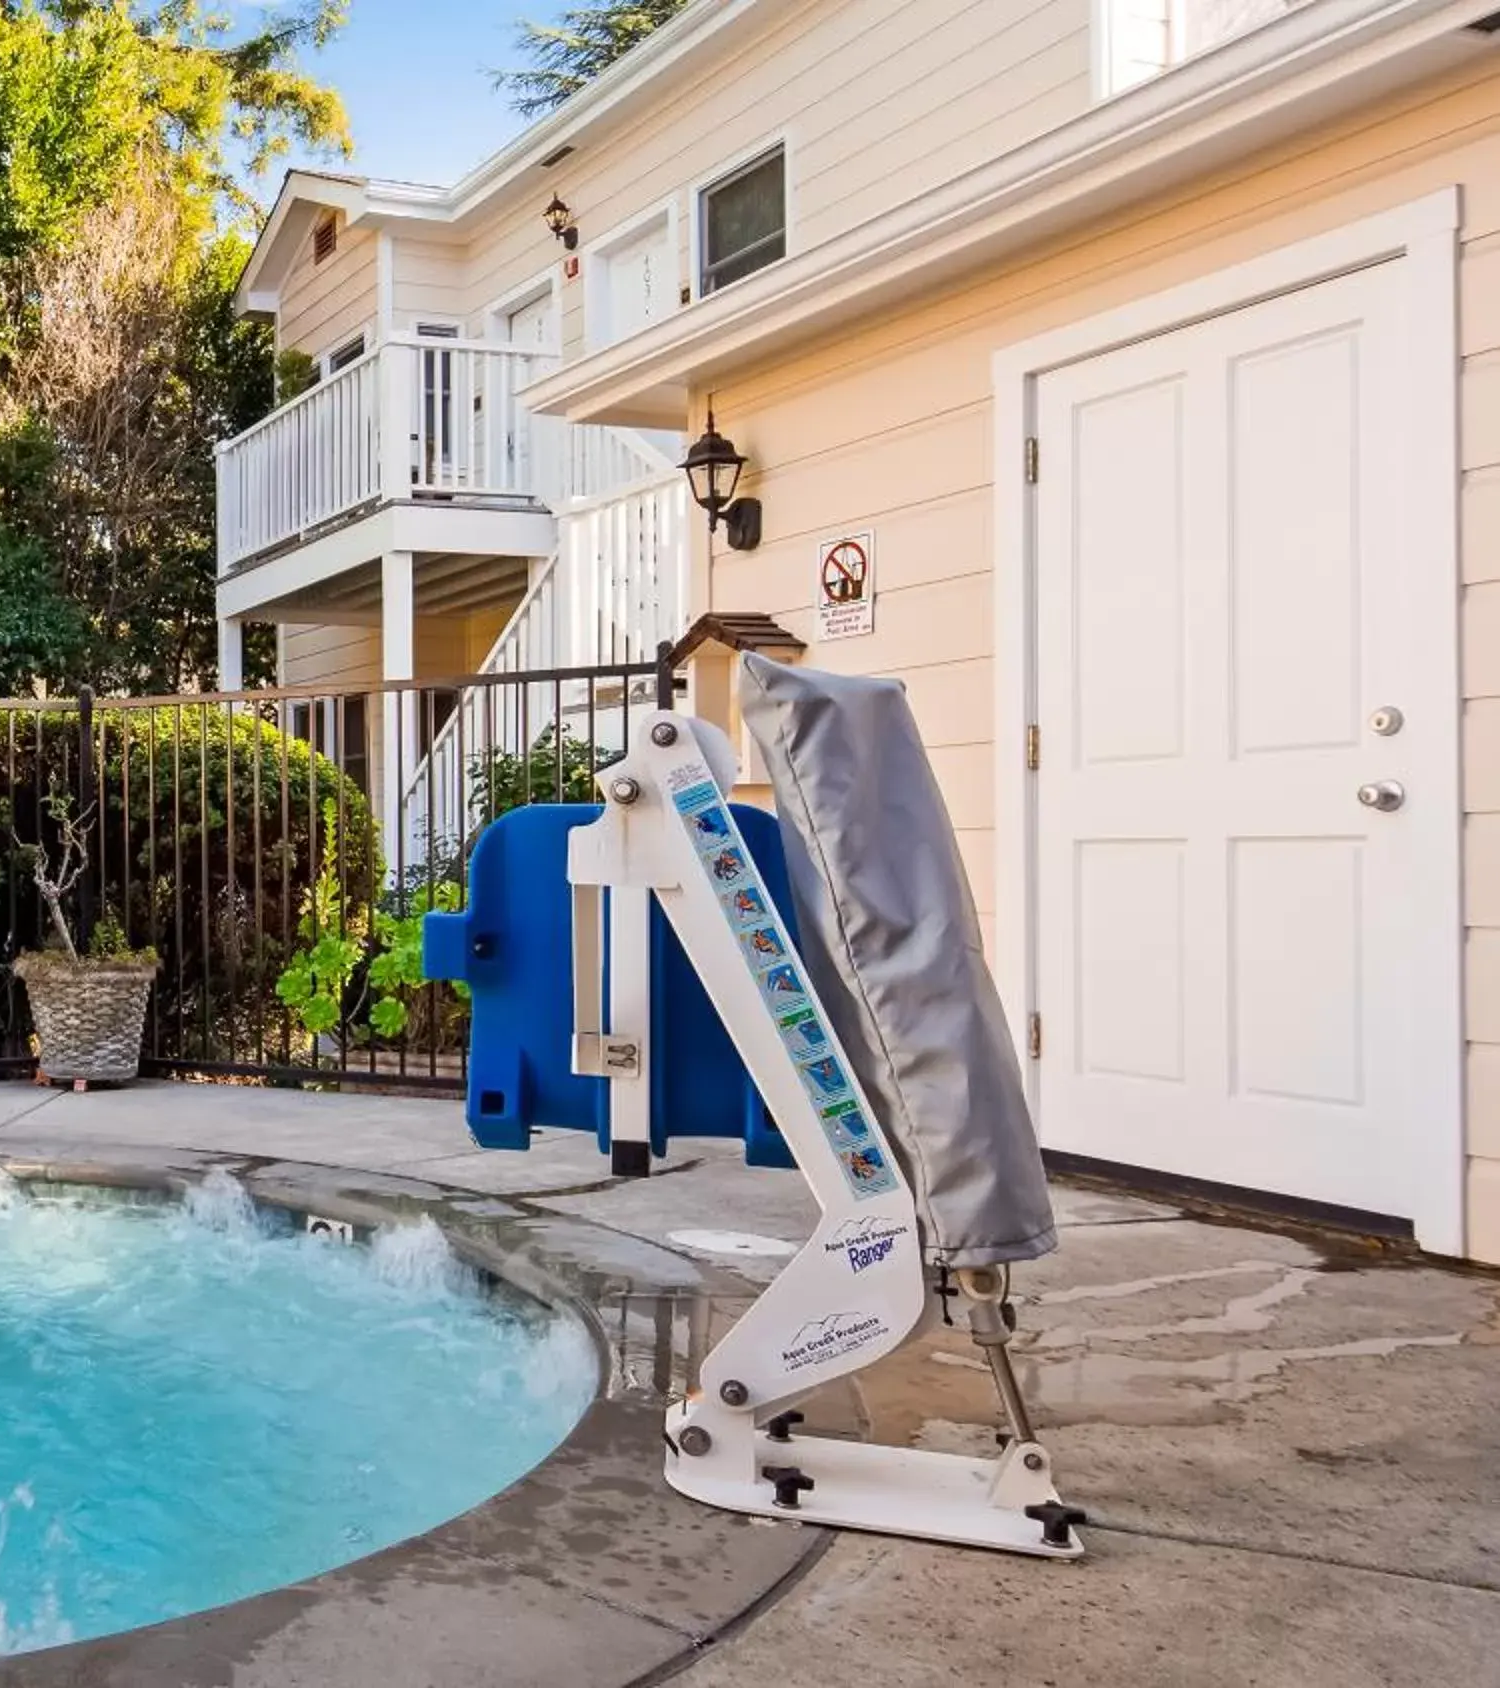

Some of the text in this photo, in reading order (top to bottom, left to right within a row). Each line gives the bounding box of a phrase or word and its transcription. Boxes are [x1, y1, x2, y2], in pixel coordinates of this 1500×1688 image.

[825, 1226, 908, 1252] Aqua Creek Products
[848, 1237, 894, 1274] Ranger
[782, 1347, 806, 1361] Aqua
[806, 1335, 835, 1350] Creek
[835, 1317, 879, 1338] Products
